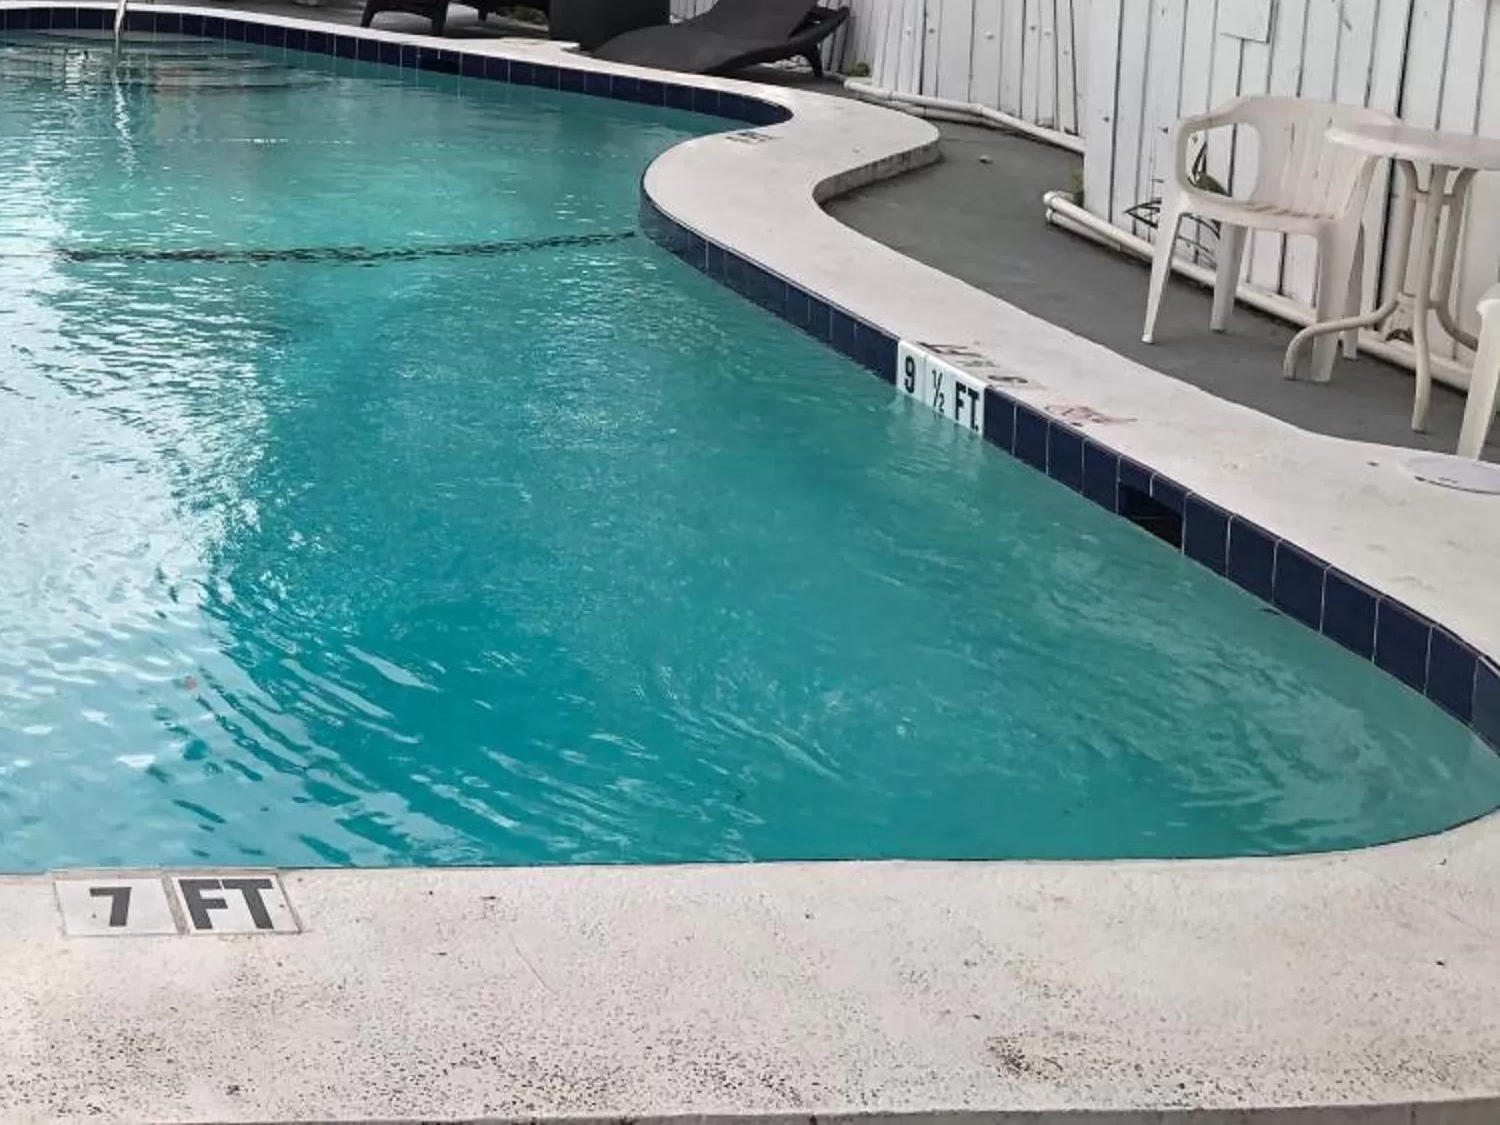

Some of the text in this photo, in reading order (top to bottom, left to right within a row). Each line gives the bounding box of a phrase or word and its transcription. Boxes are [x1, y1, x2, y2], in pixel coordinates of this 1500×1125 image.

[904, 355, 916, 394] 9
[89, 878, 274, 929] 7 FT
